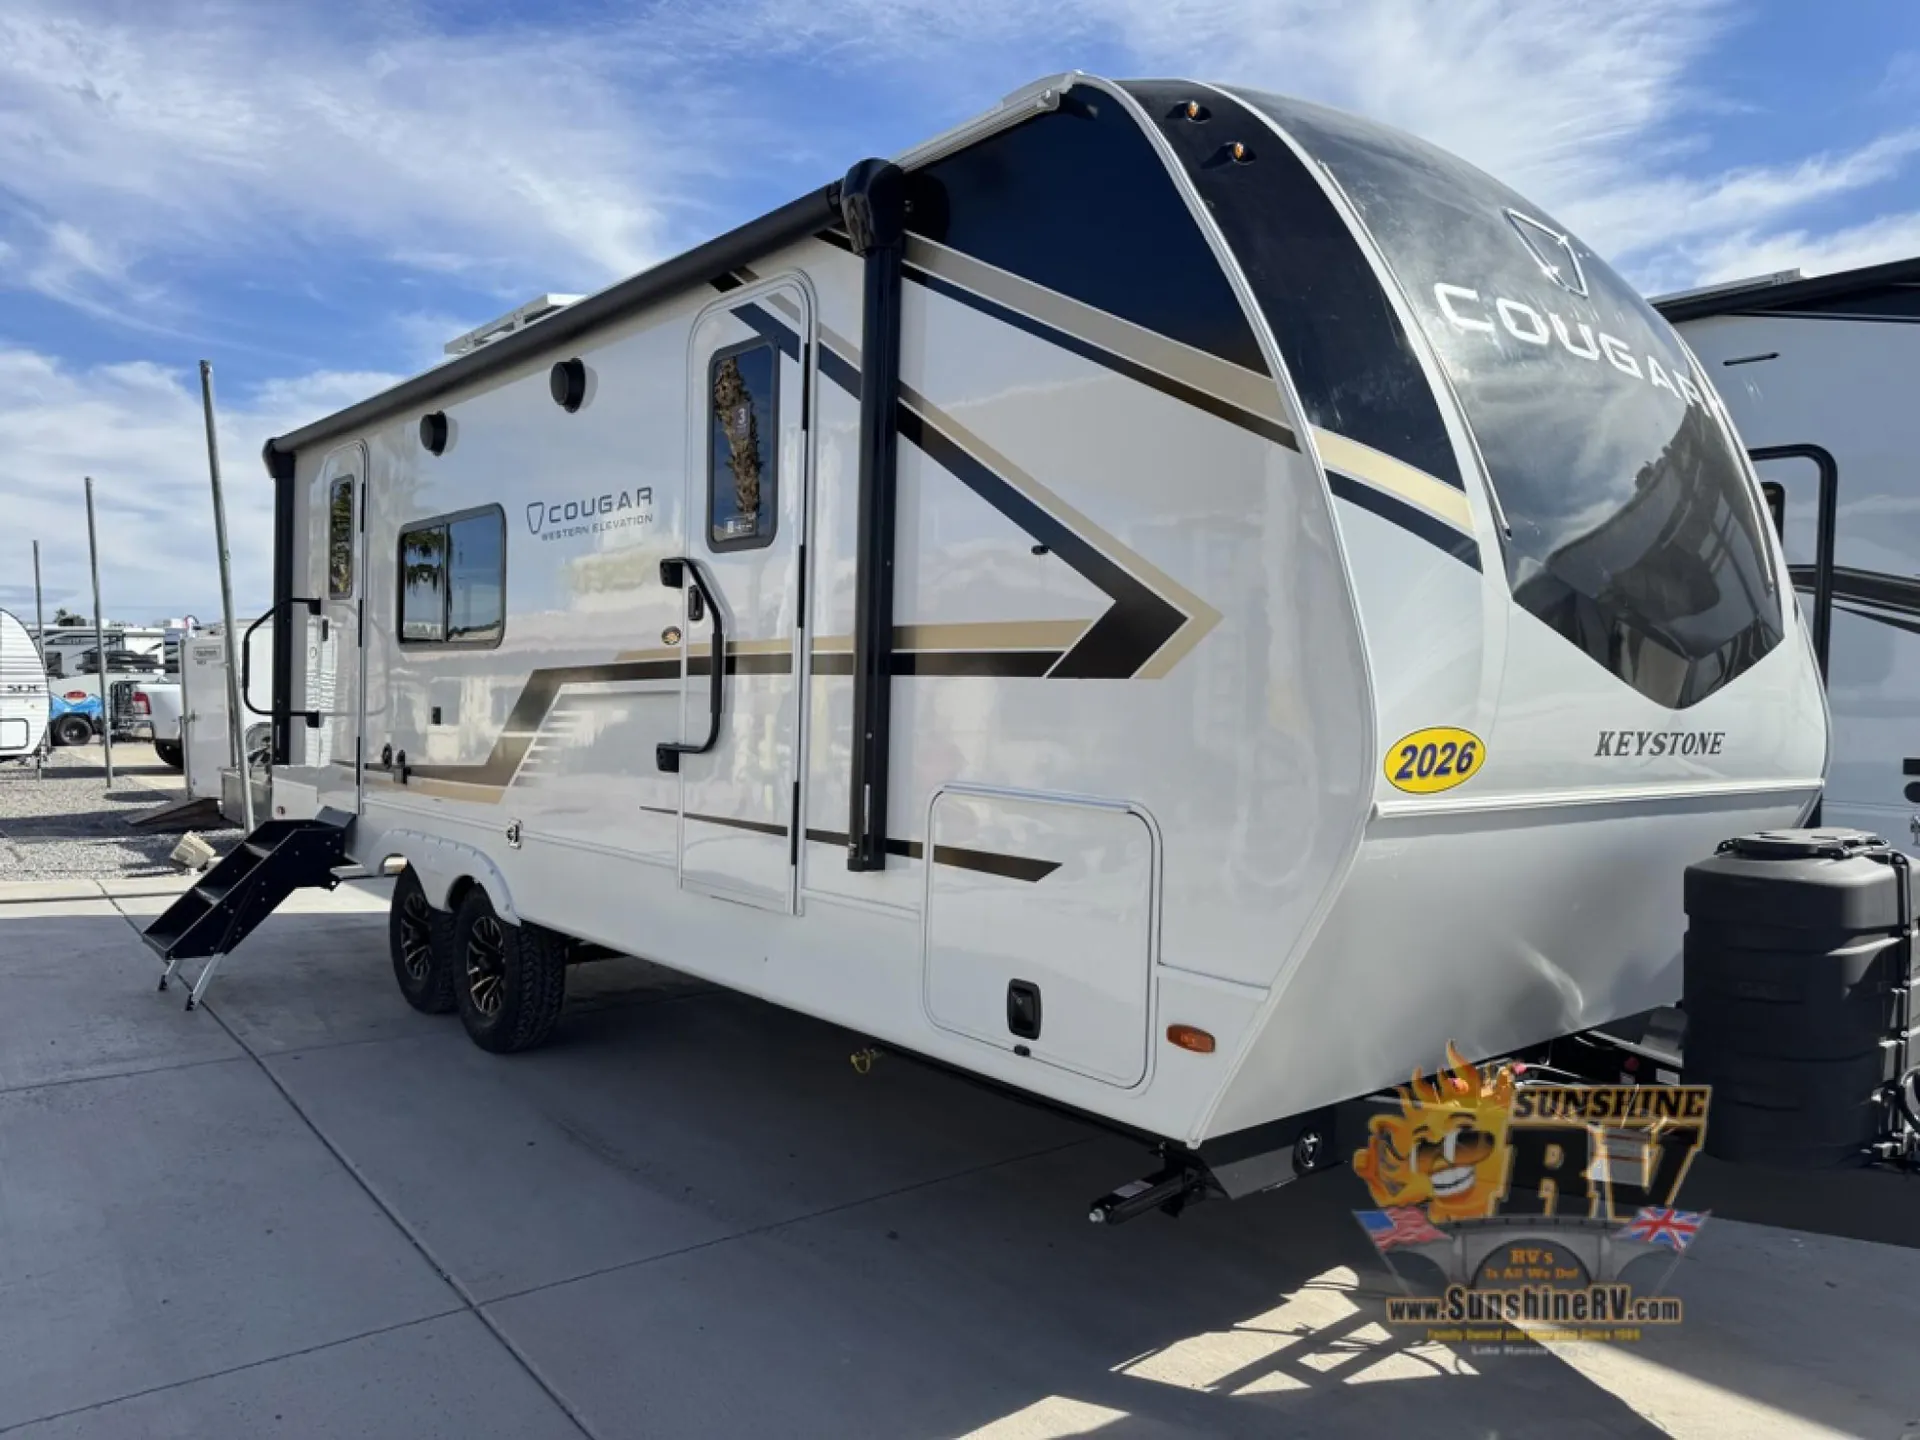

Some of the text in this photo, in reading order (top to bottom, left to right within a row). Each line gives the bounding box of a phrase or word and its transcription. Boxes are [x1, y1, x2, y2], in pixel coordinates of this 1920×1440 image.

[1433, 283, 1712, 416] COUGAR
[549, 487, 653, 523] COUGAR
[541, 514, 653, 541] WESTERN ELEVATION
[1394, 741, 1477, 780] 2026
[1594, 731, 1726, 756] KEYSTONE
